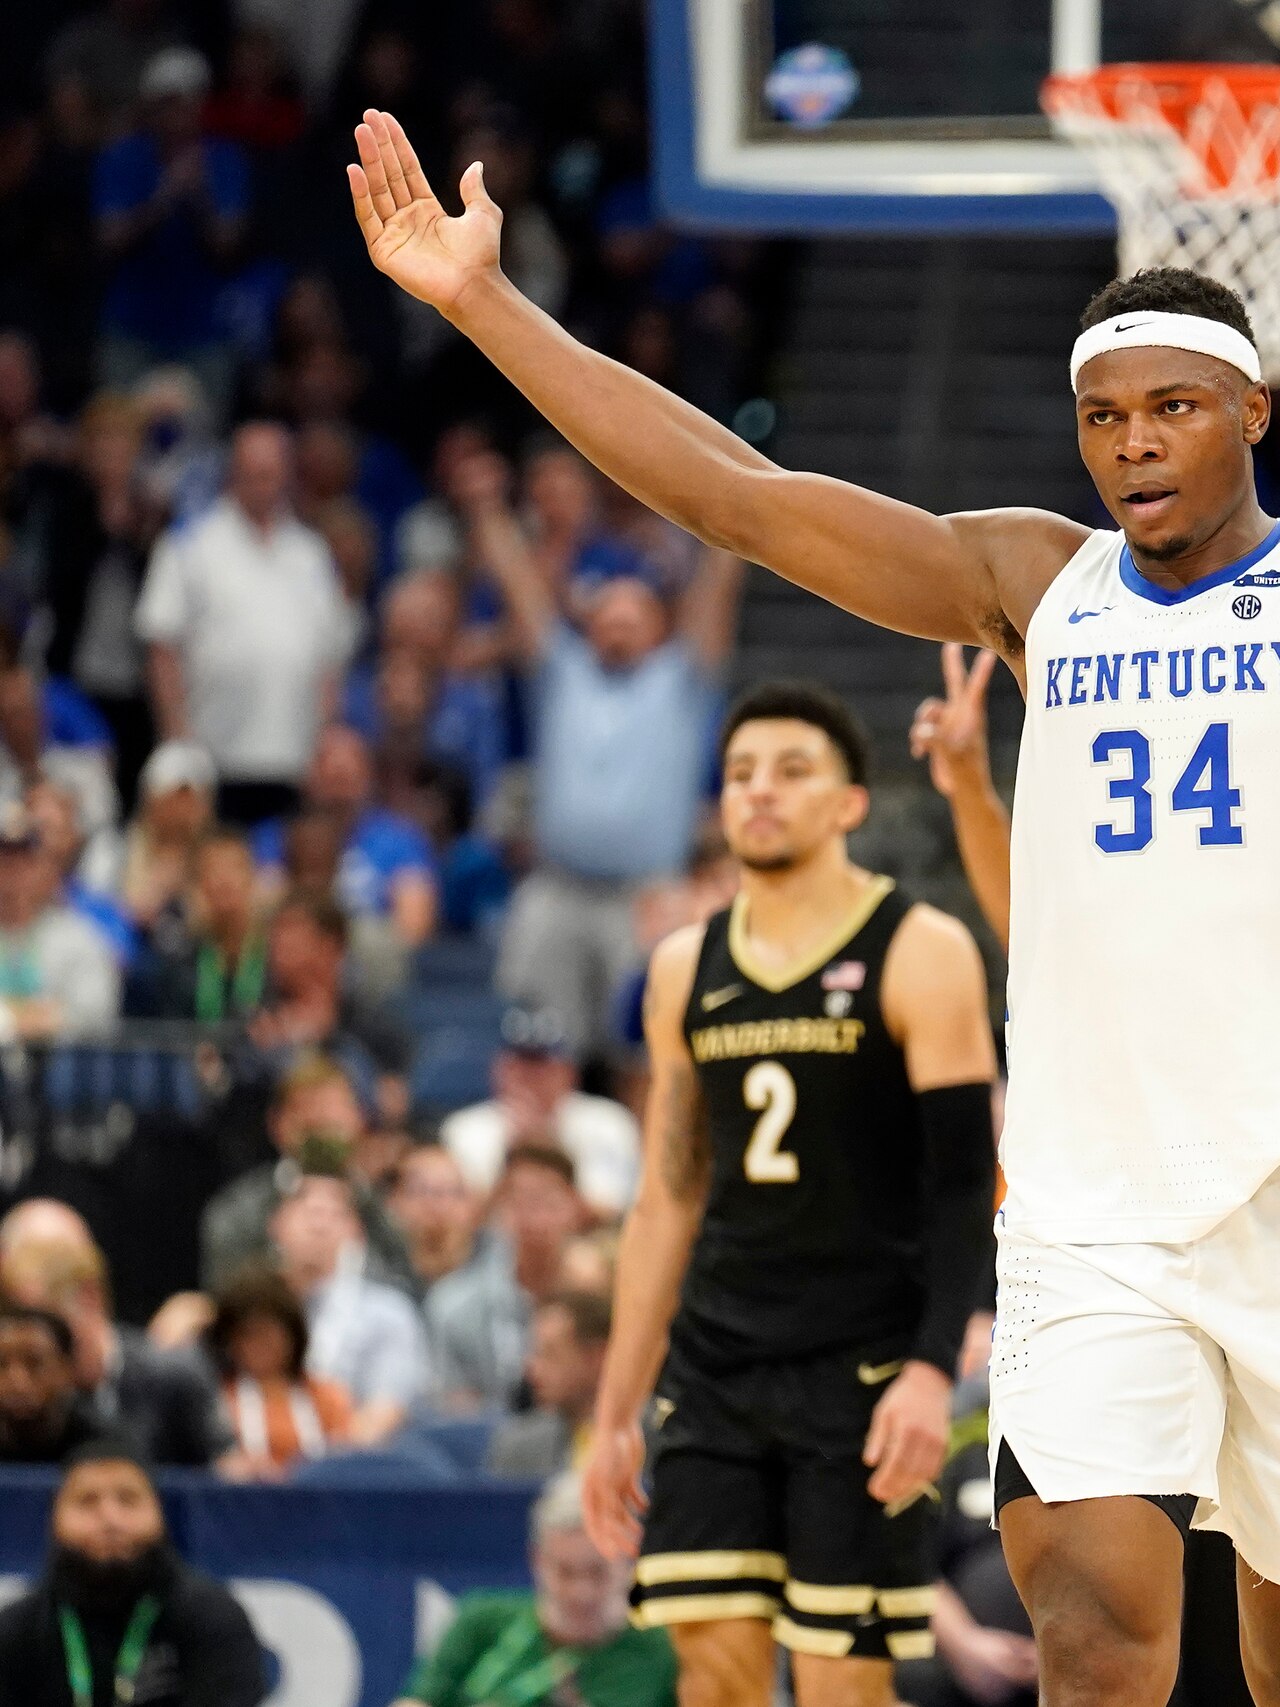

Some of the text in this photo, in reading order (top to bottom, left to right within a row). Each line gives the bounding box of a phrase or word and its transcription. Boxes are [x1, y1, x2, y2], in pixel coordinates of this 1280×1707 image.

[1234, 595, 1260, 618] SEC
[1090, 719, 1247, 858] 34
[742, 1060, 799, 1184] 2
